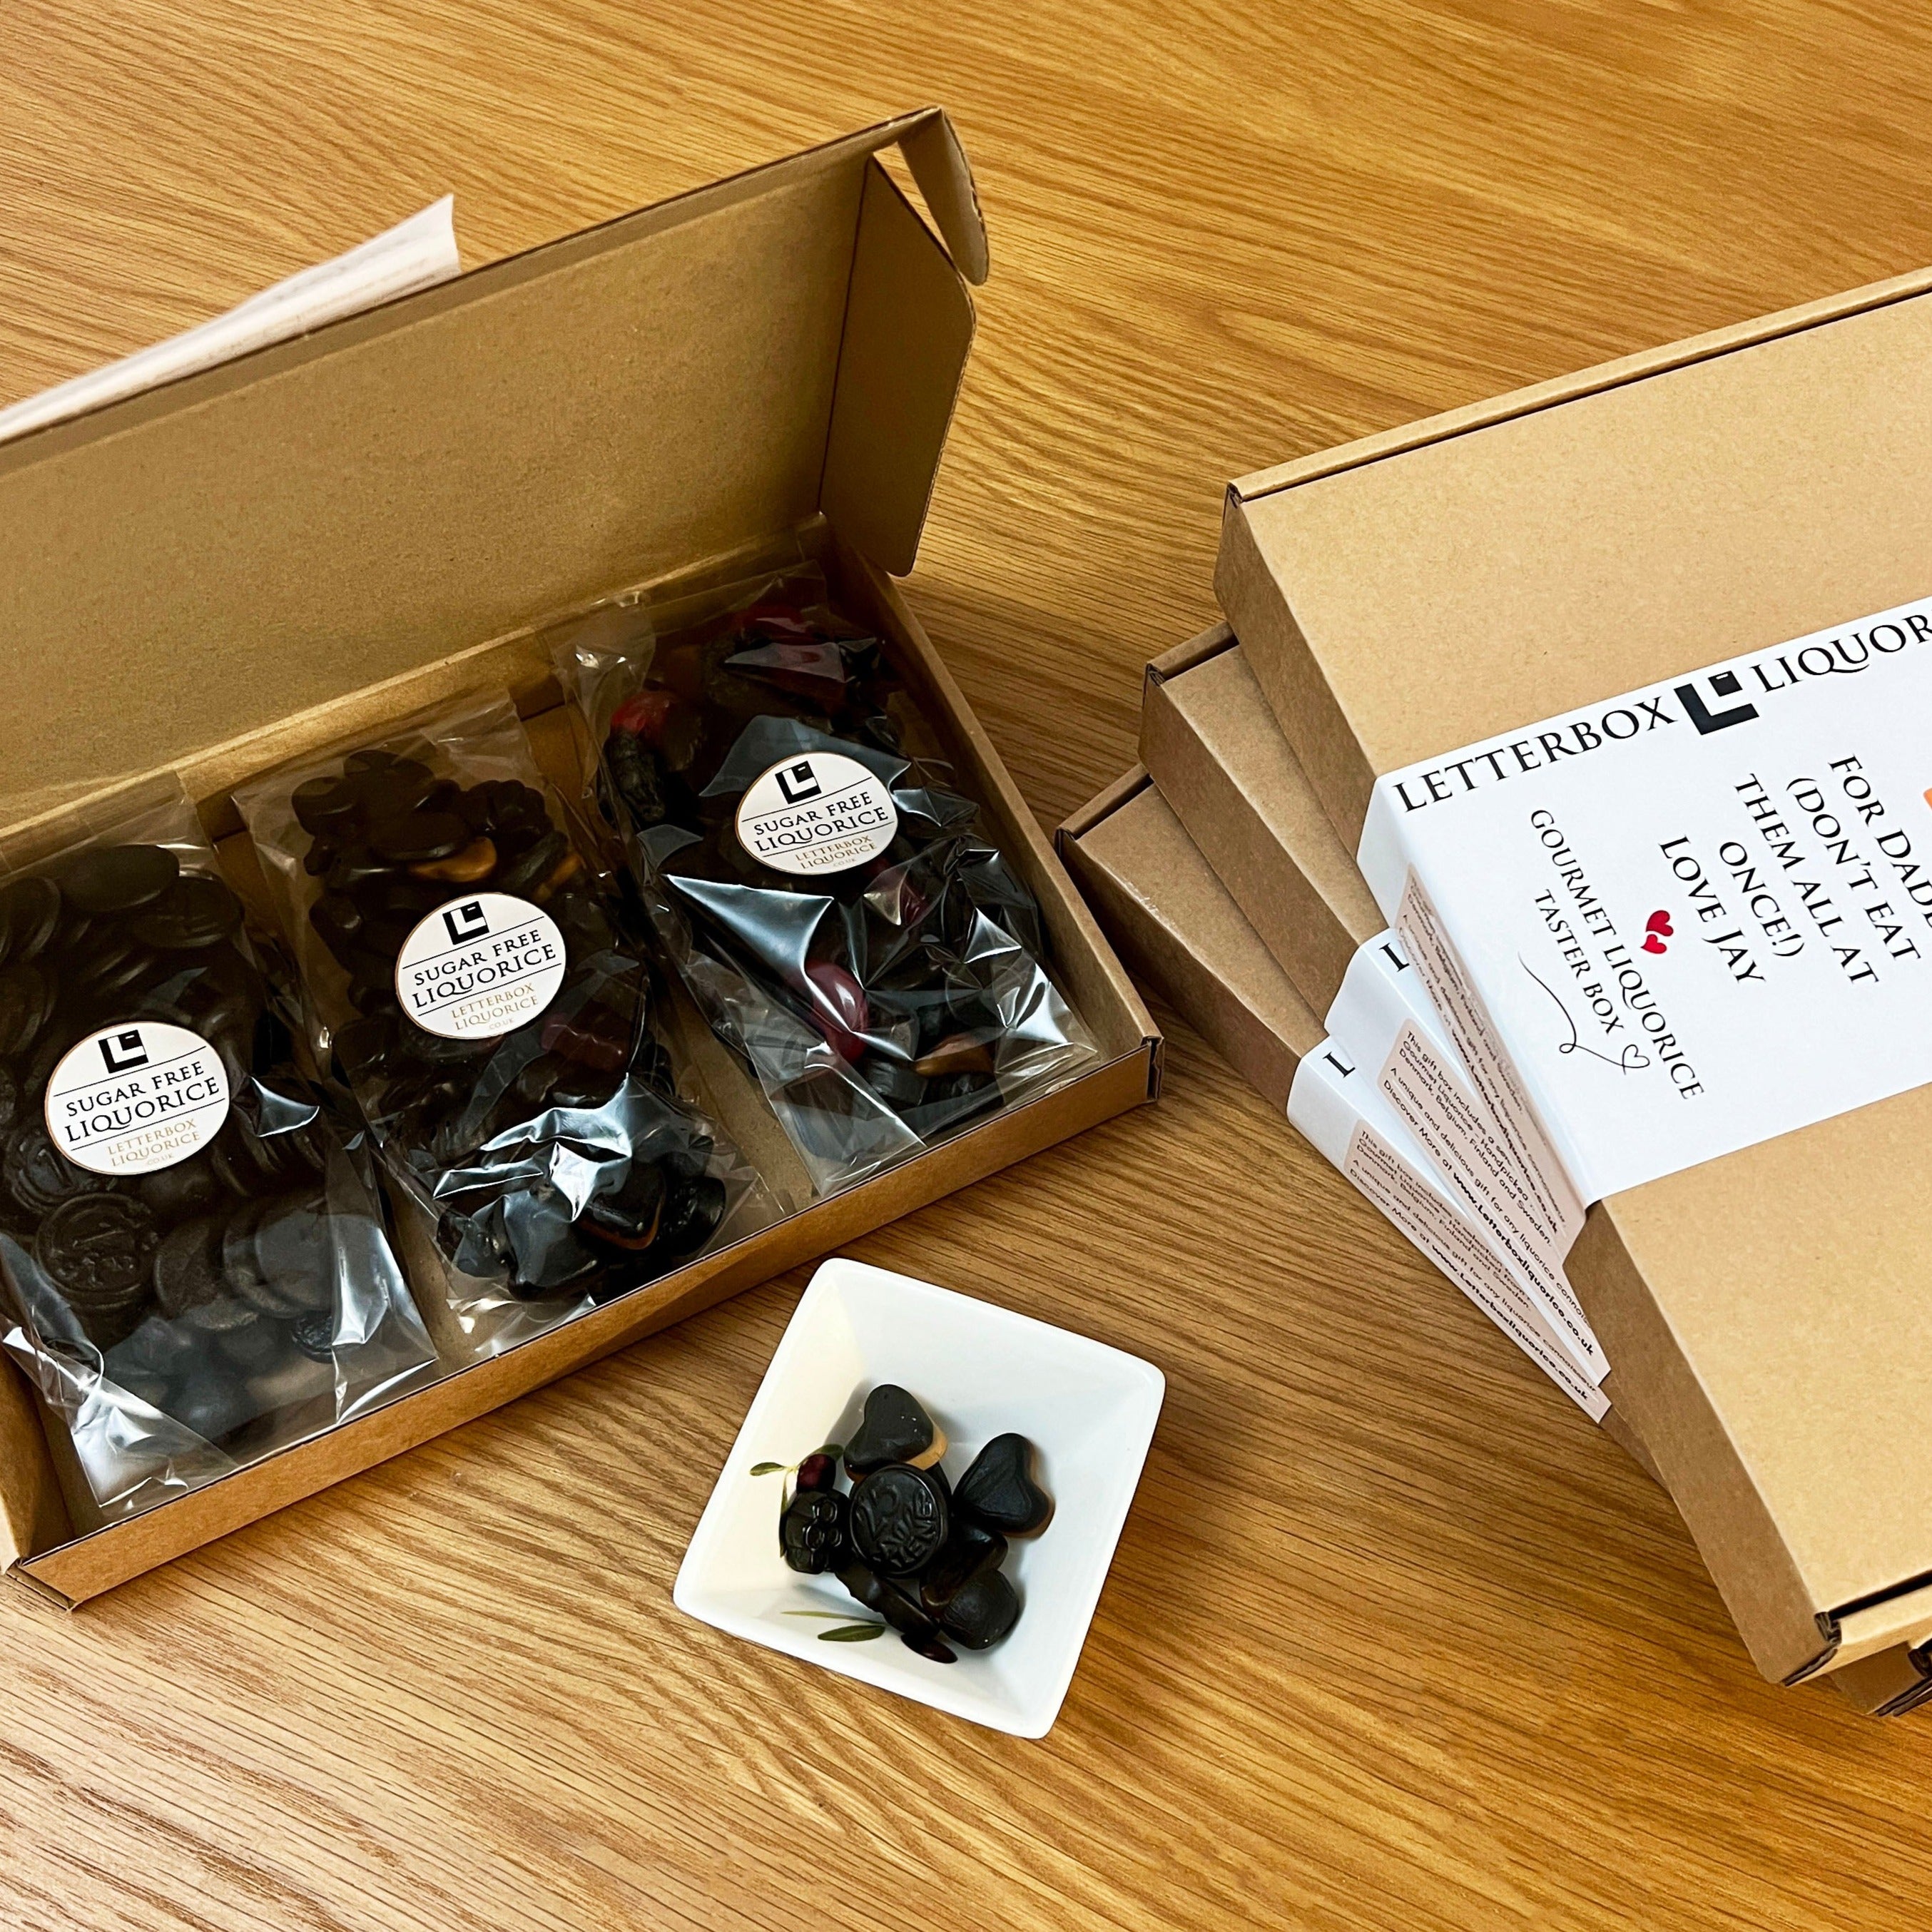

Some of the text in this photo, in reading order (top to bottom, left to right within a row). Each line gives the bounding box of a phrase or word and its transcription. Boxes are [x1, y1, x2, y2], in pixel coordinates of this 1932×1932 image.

[1391, 696, 1679, 814] LETTERBOX
[1749, 609, 1932, 693] LIQUOR
[754, 791, 873, 835] SUGAR FREE
[754, 807, 888, 852] LIQUORICE
[795, 835, 873, 861] LETTERBOX
[800, 843, 878, 870] LIQUORICE
[1828, 753, 1932, 928] FOR DAD
[1659, 834, 1766, 985] LOVE JAY
[1718, 841, 1806, 958] ONCE!)
[1734, 773, 1880, 985] THEM ALL AT
[1786, 777, 1921, 961] (DON'T EAT
[412, 944, 556, 1008] LIQUORICE
[414, 930, 542, 986] SUGAR FREE
[1530, 808, 1705, 1100] GOURMET LIQUORICE
[1534, 888, 1625, 1035] TASTER BOX
[451, 982, 535, 1019] LETTERBOX
[454, 995, 539, 1030] LIQUORICE
[64, 1077, 220, 1142] LIQUORICE
[66, 1061, 205, 1117] SUGAR FREE
[1383, 1079, 1419, 1126] Discover
[1419, 1127, 1440, 1157] More
[1443, 1159, 1453, 1171] at
[1399, 1048, 1434, 1097] Denmark,
[1435, 1094, 1468, 1140] Belgium,
[1469, 1138, 1500, 1177] Finland
[1499, 1179, 1517, 1199] and
[1403, 1041, 1437, 1084] Gourmet
[1438, 1084, 1474, 1132] Liquorice
[1407, 1030, 1494, 1144] This gift box includes a
[107, 1119, 197, 1155] LETTERBOX
[111, 1131, 200, 1166] LIQUORICE
[1358, 1138, 1398, 1175] Gourmet
[1399, 1174, 1440, 1214] Liquorice
[1361, 1130, 1378, 1149] This
[1378, 1149, 1395, 1164] gift
[1396, 1164, 1413, 1181] box
[1415, 1181, 1453, 1219] includes
[1390, 1067, 1397, 1077] A
[1398, 1077, 1423, 1109] unique
[1424, 1112, 1440, 1132] and
[1440, 1132, 1475, 1177] delicious
[1475, 1179, 1490, 1196] gift
[1491, 1196, 1503, 1213] for
[1504, 1215, 1519, 1234] any
[1520, 1234, 1555, 1280] liquorice
[1350, 1168, 1390, 1207] Discover
[1392, 1207, 1417, 1232] More
[1419, 1233, 1430, 1244] at
[1356, 1144, 1398, 1184] Denmark,
[1400, 1183, 1437, 1220] Belgium,
[1438, 1219, 1471, 1252] Finland
[1473, 1253, 1491, 1271] and
[1361, 1167, 1391, 1194] unique
[1393, 1194, 1411, 1211] and
[1413, 1211, 1450, 1250] delicious
[1452, 1251, 1468, 1266] gift
[1470, 1266, 1483, 1281] for
[1484, 1282, 1500, 1298] any
[1502, 1298, 1541, 1338] liquorice
